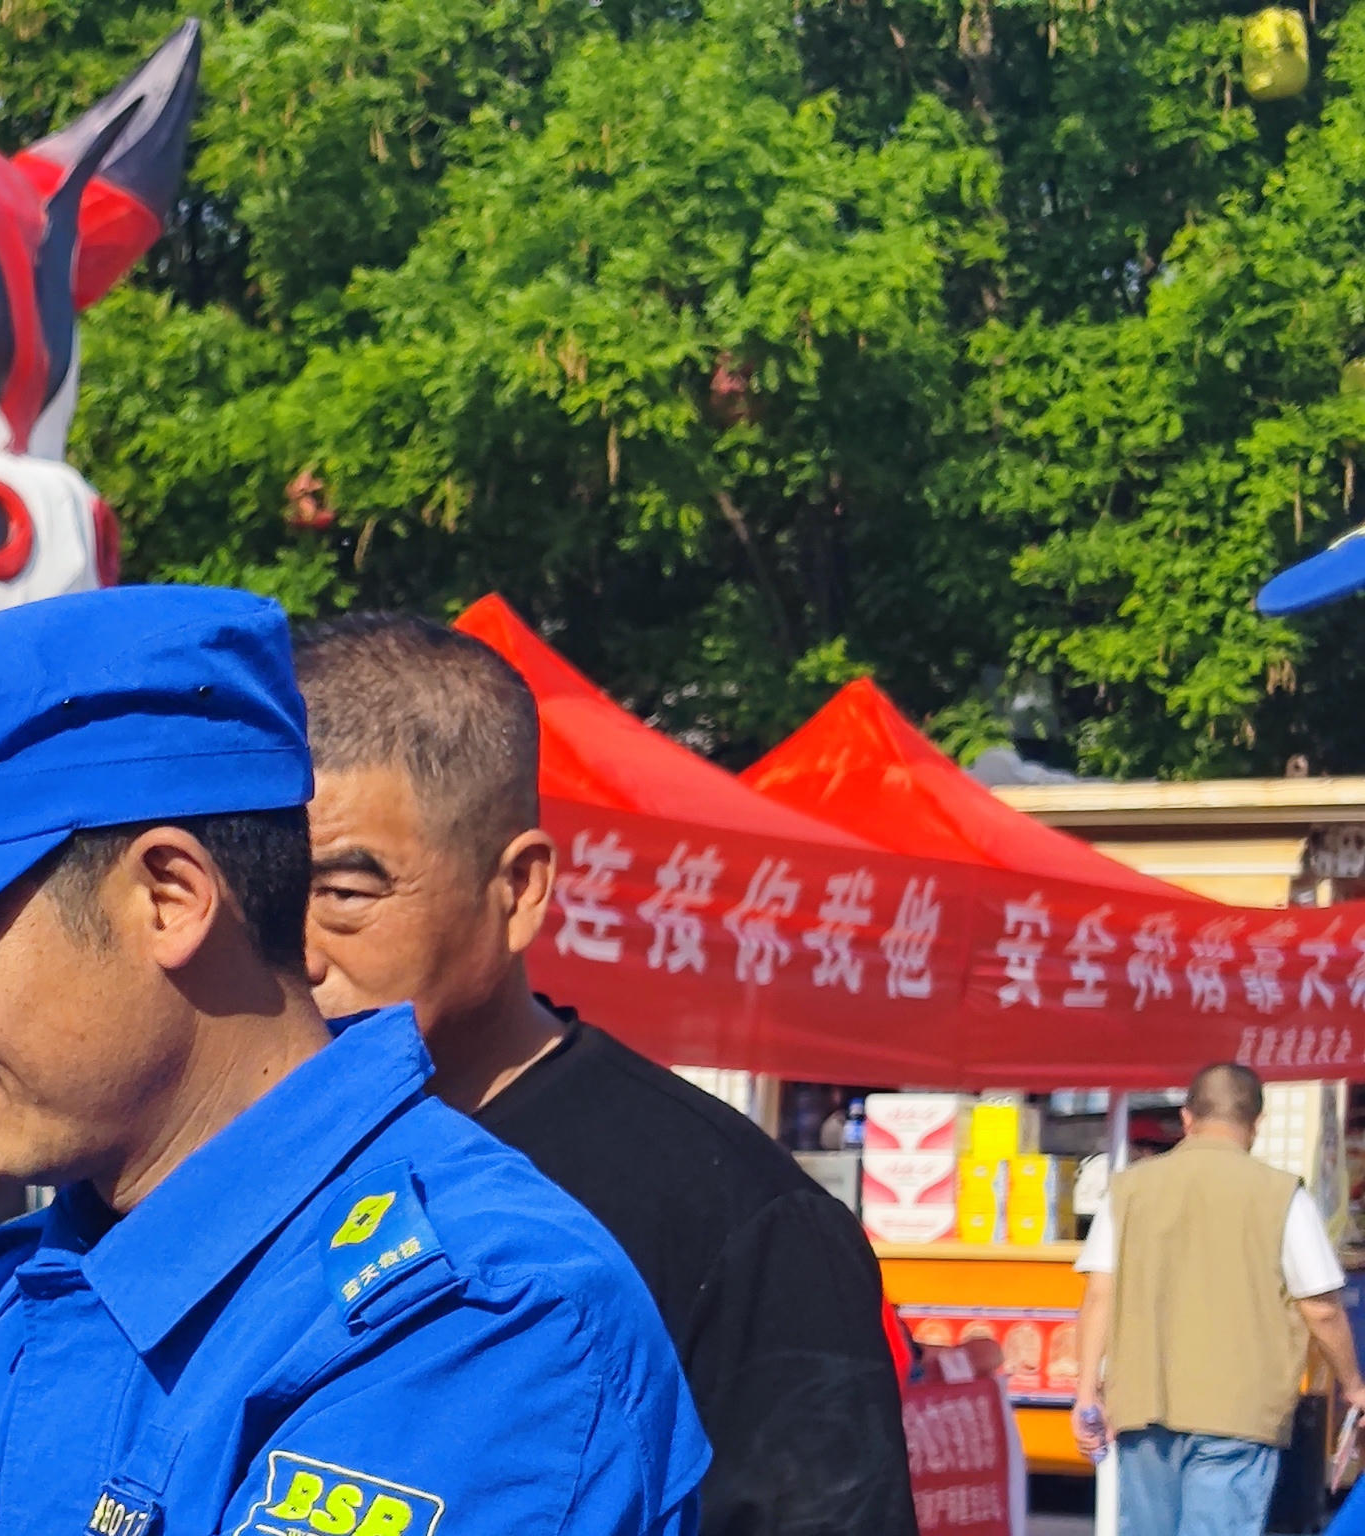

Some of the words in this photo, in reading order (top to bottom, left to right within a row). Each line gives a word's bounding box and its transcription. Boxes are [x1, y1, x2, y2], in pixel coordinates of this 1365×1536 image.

[554, 828, 944, 1001] 连接你我他
